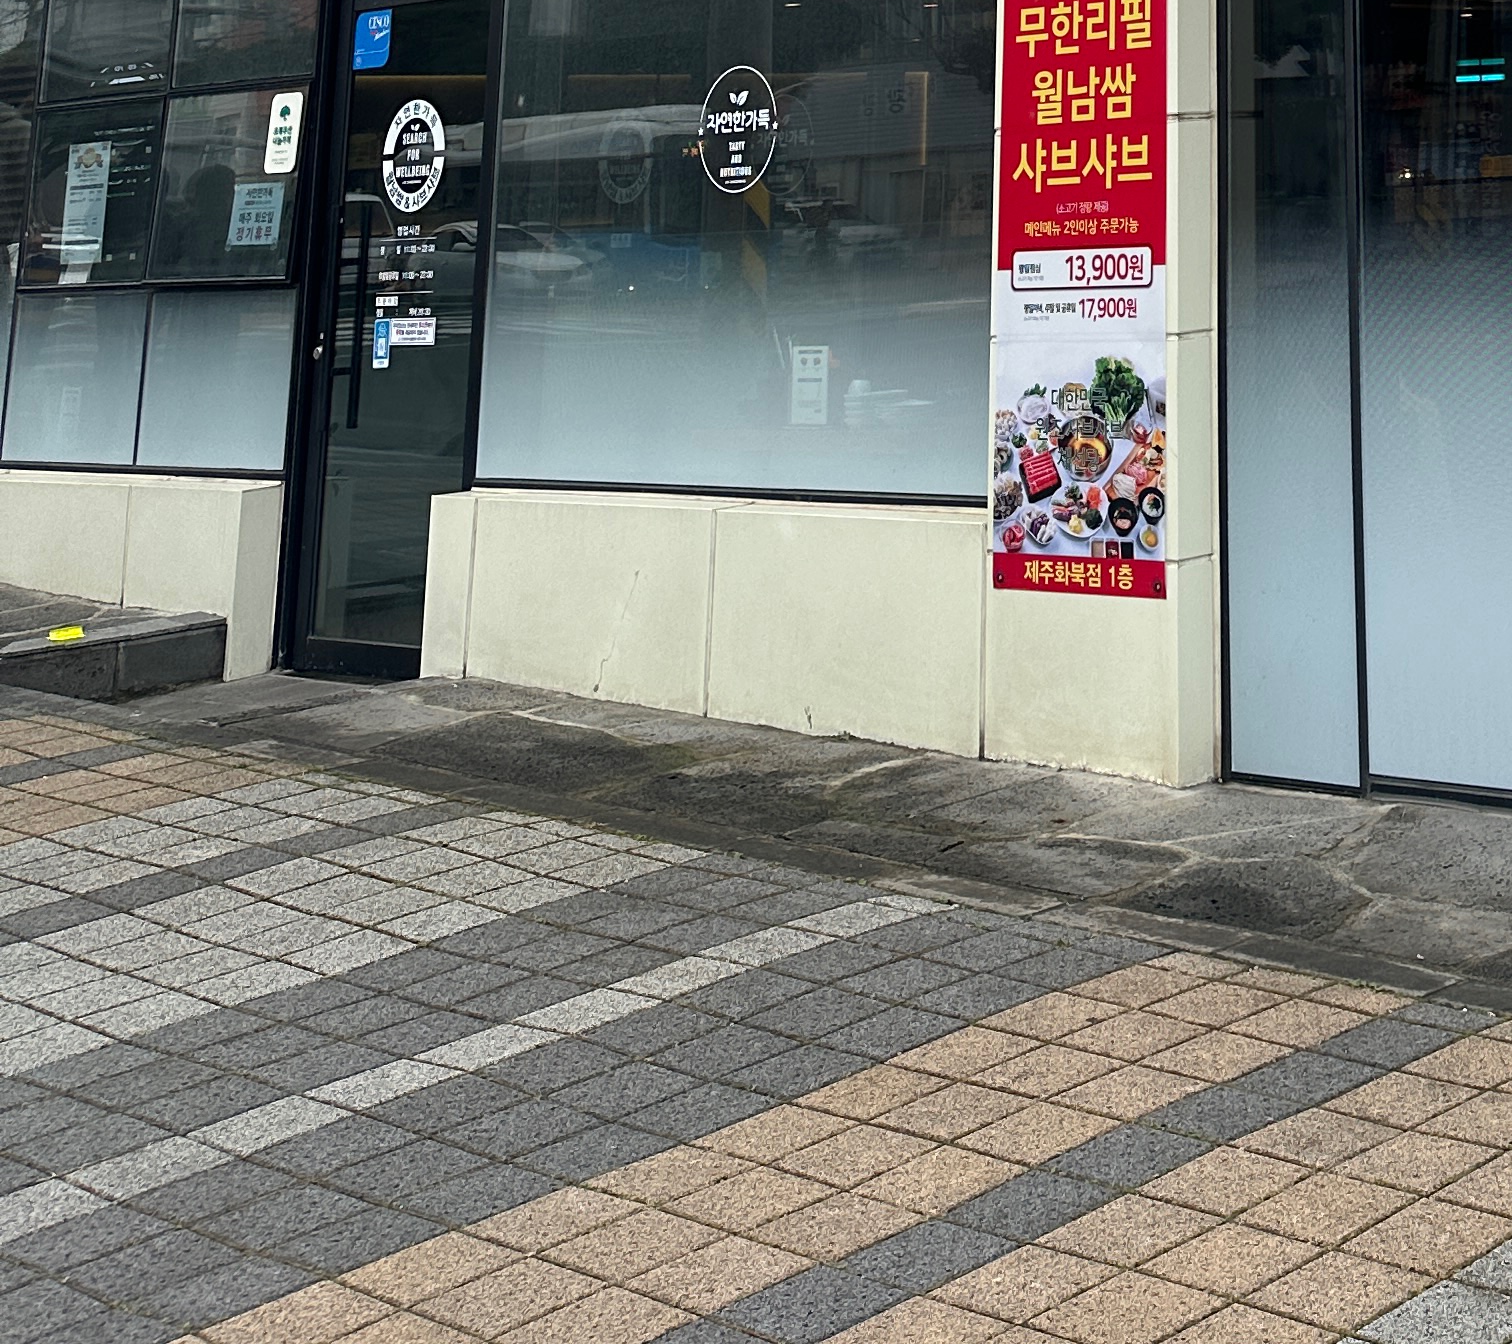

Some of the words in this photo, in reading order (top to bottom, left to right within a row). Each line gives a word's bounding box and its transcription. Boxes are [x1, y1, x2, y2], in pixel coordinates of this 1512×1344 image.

[1031, 62, 1137, 126] 월남쌈
[706, 108, 771, 135] 자연한가득
[402, 131, 428, 146] SEARCH
[406, 148, 420, 161] FOR
[1011, 133, 1153, 194] 샤브샤브
[395, 164, 431, 178] WELLBEING
[1063, 218, 1098, 236] 2인이상
[1099, 216, 1140, 235] 주문가능
[1065, 253, 1144, 286] 13,900원
[1078, 297, 1138, 322] 17,900원
[1023, 559, 1102, 588] 제주화북점
[1108, 562, 1134, 590] 1층
